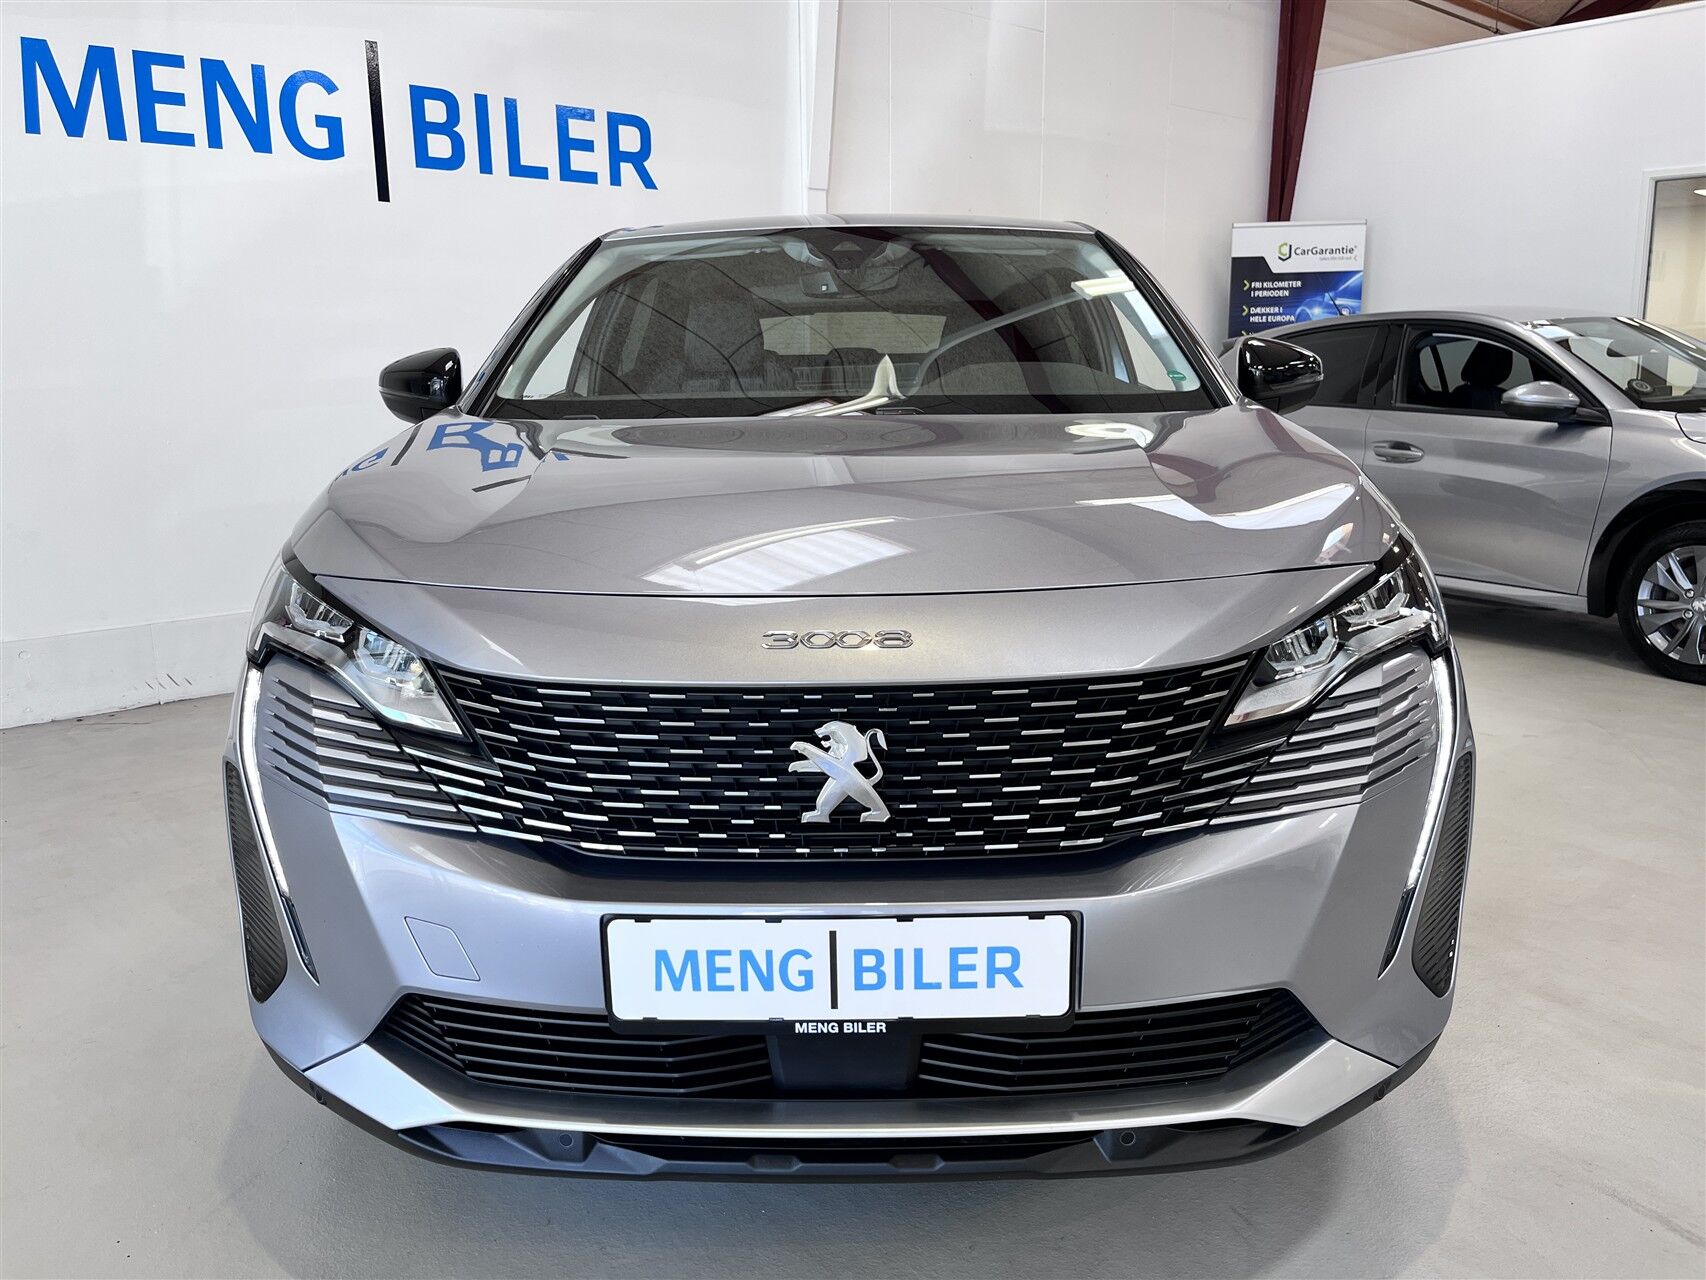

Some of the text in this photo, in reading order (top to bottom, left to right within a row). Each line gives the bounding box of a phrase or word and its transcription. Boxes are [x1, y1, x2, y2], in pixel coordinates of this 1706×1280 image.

[20, 36, 659, 191] MENG BILER
[1294, 246, 1354, 256] CarGarantie
[1268, 315, 1296, 323] EUROPA
[761, 629, 914, 650] 3008
[653, 945, 1024, 993] MENG BILER
[794, 1022, 887, 1034] MENG BILER
